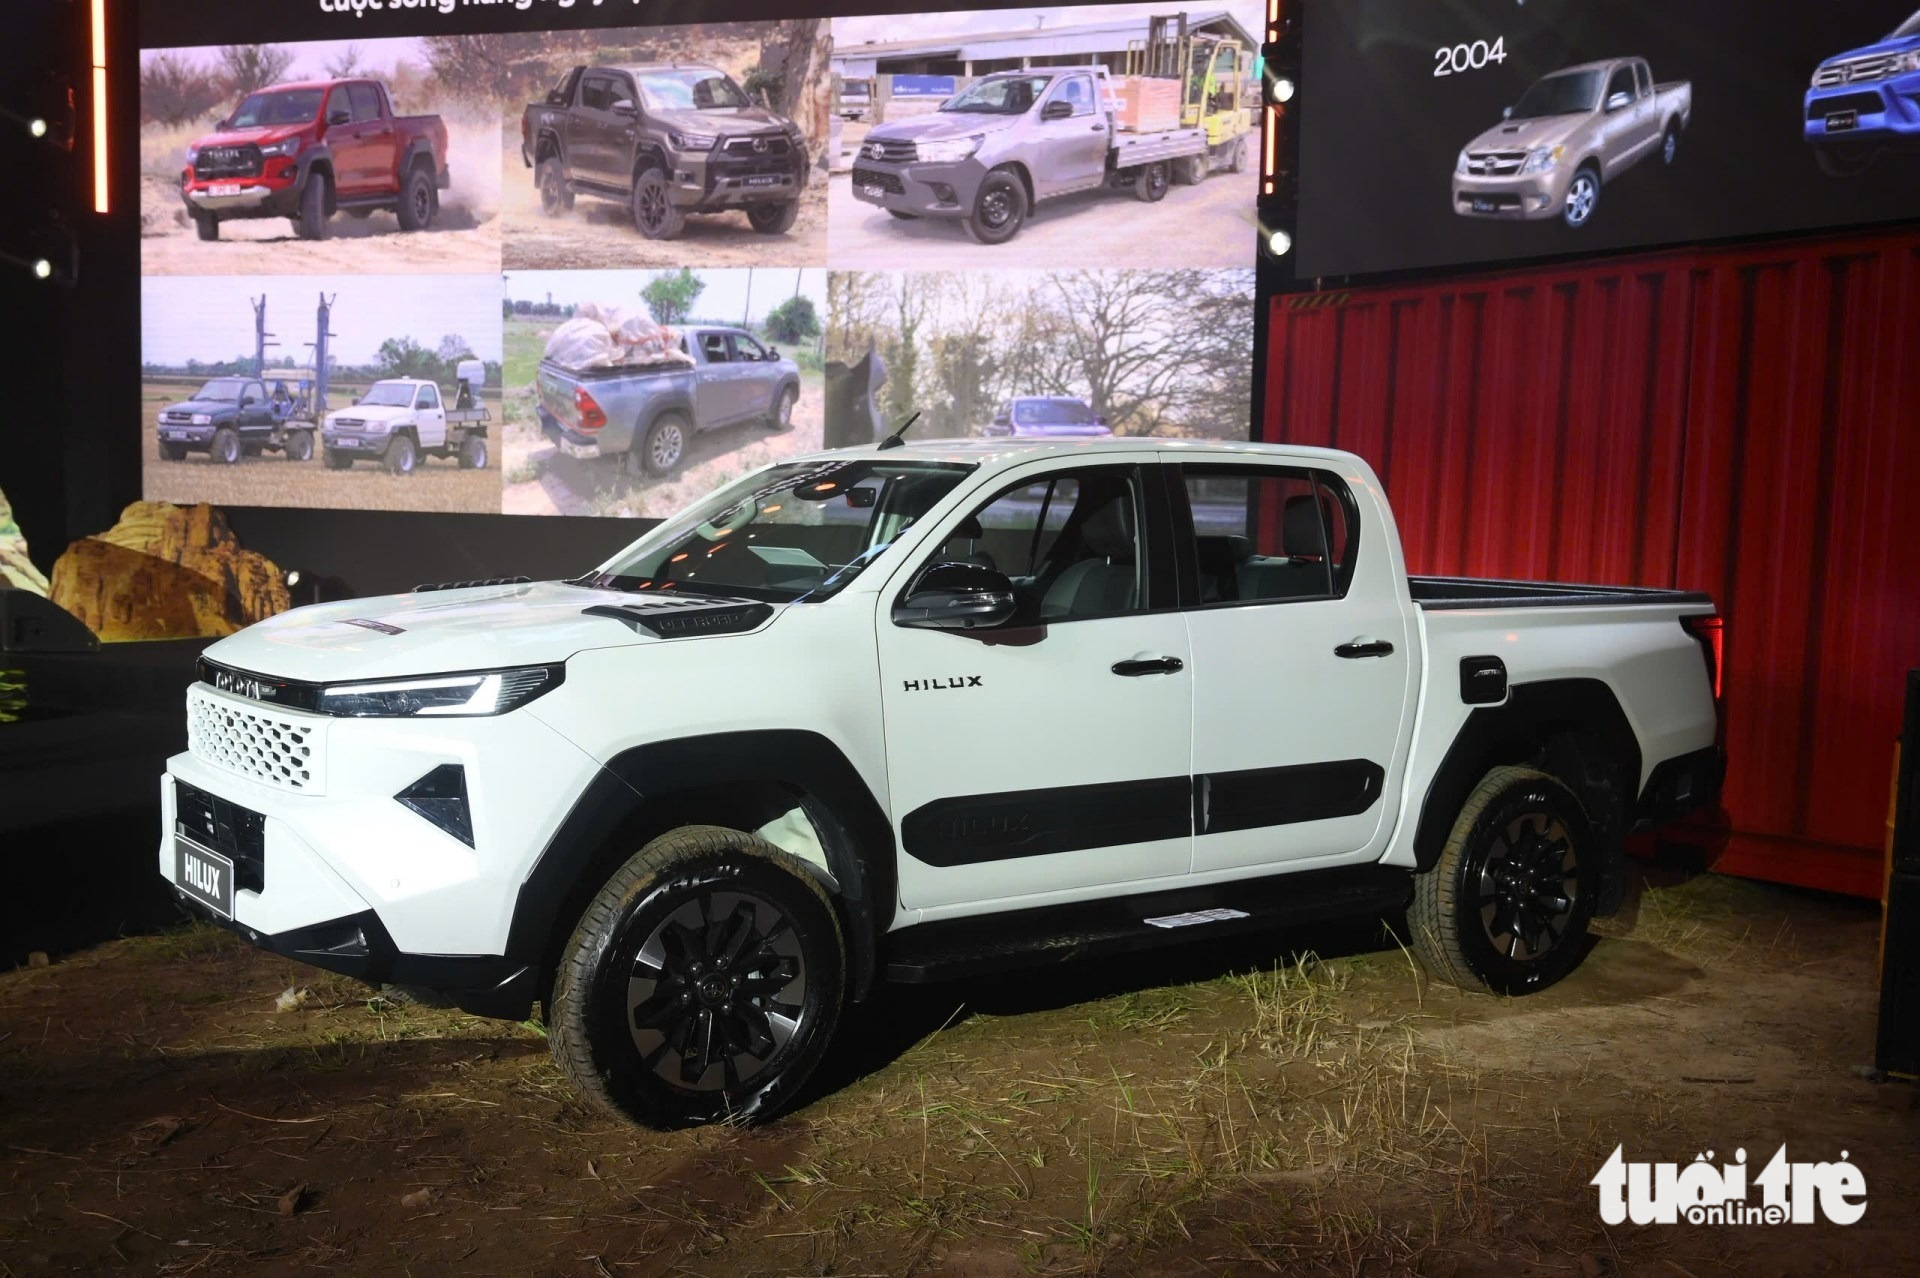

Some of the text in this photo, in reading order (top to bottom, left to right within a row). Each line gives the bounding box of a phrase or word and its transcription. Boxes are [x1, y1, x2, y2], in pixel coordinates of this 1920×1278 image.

[1434, 36, 1507, 77] 2004
[903, 675, 983, 691] HILUX
[184, 852, 221, 900] HILUX
